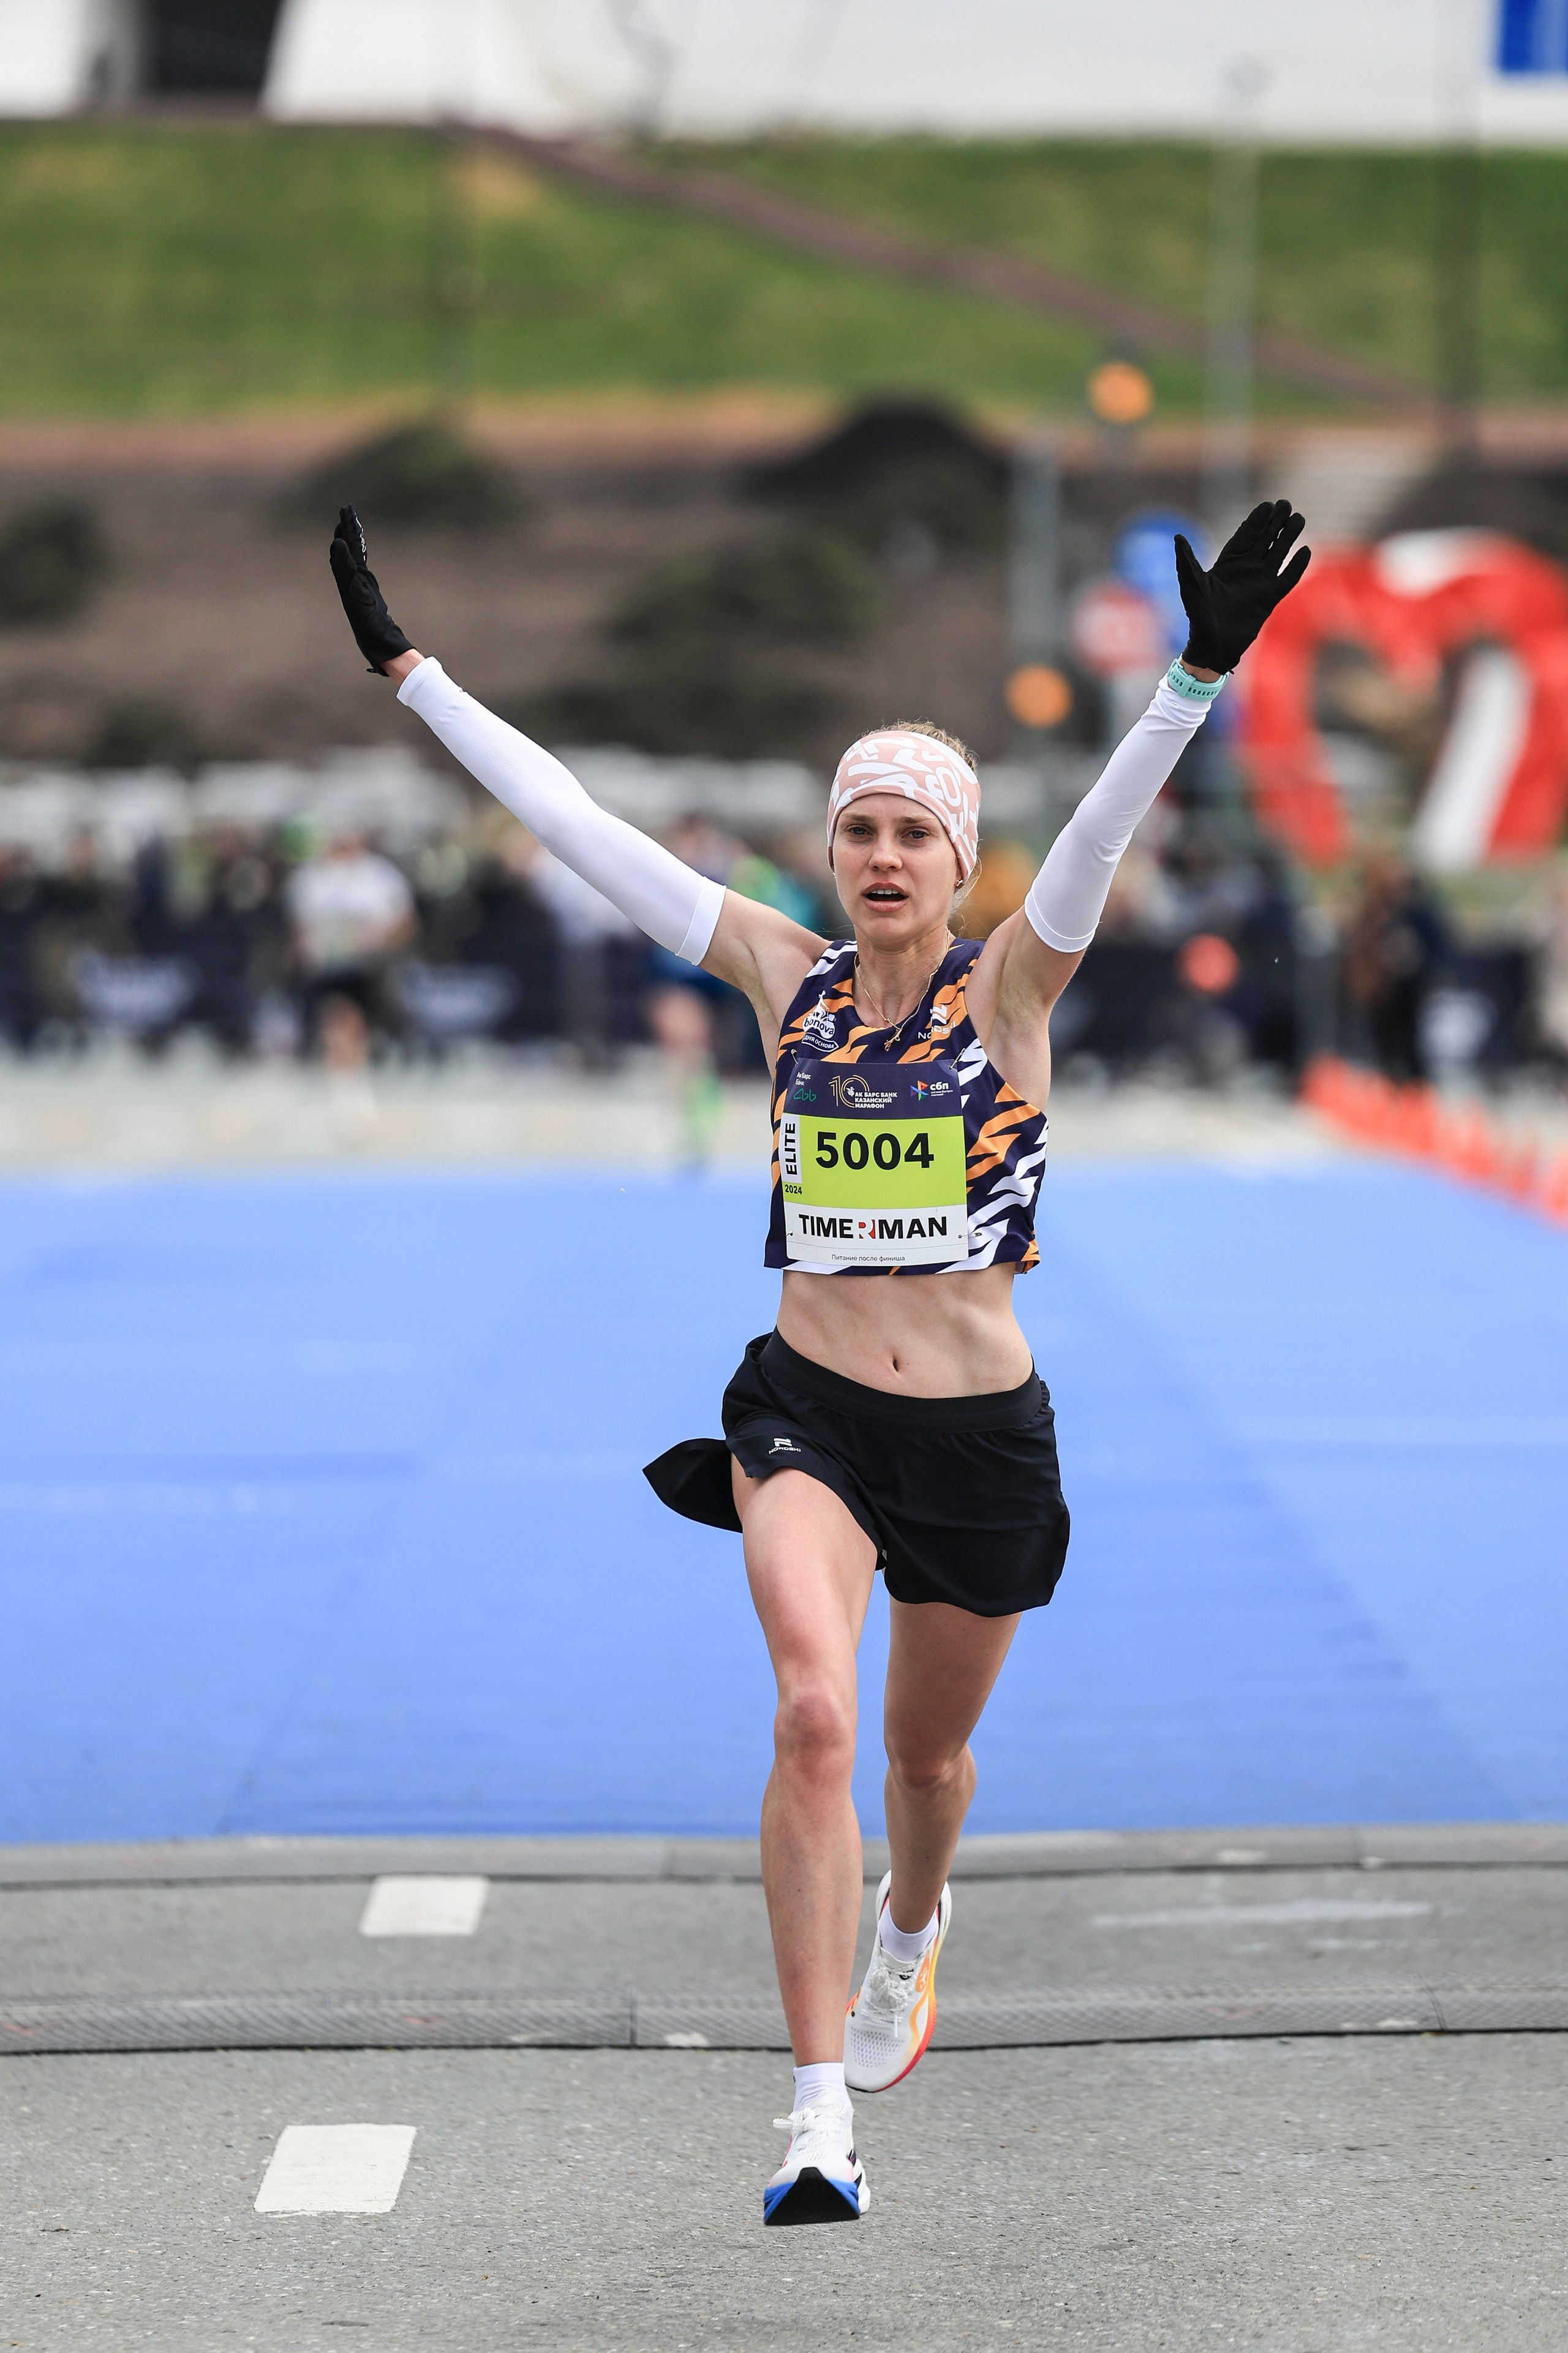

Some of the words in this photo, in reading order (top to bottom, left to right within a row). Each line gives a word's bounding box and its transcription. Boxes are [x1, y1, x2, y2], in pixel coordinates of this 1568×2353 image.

[815, 1039, 834, 1048] ОСНОВА
[785, 1123, 797, 1175] ELITE
[815, 1131, 935, 1171] 5004
[785, 1184, 802, 1195] 2024
